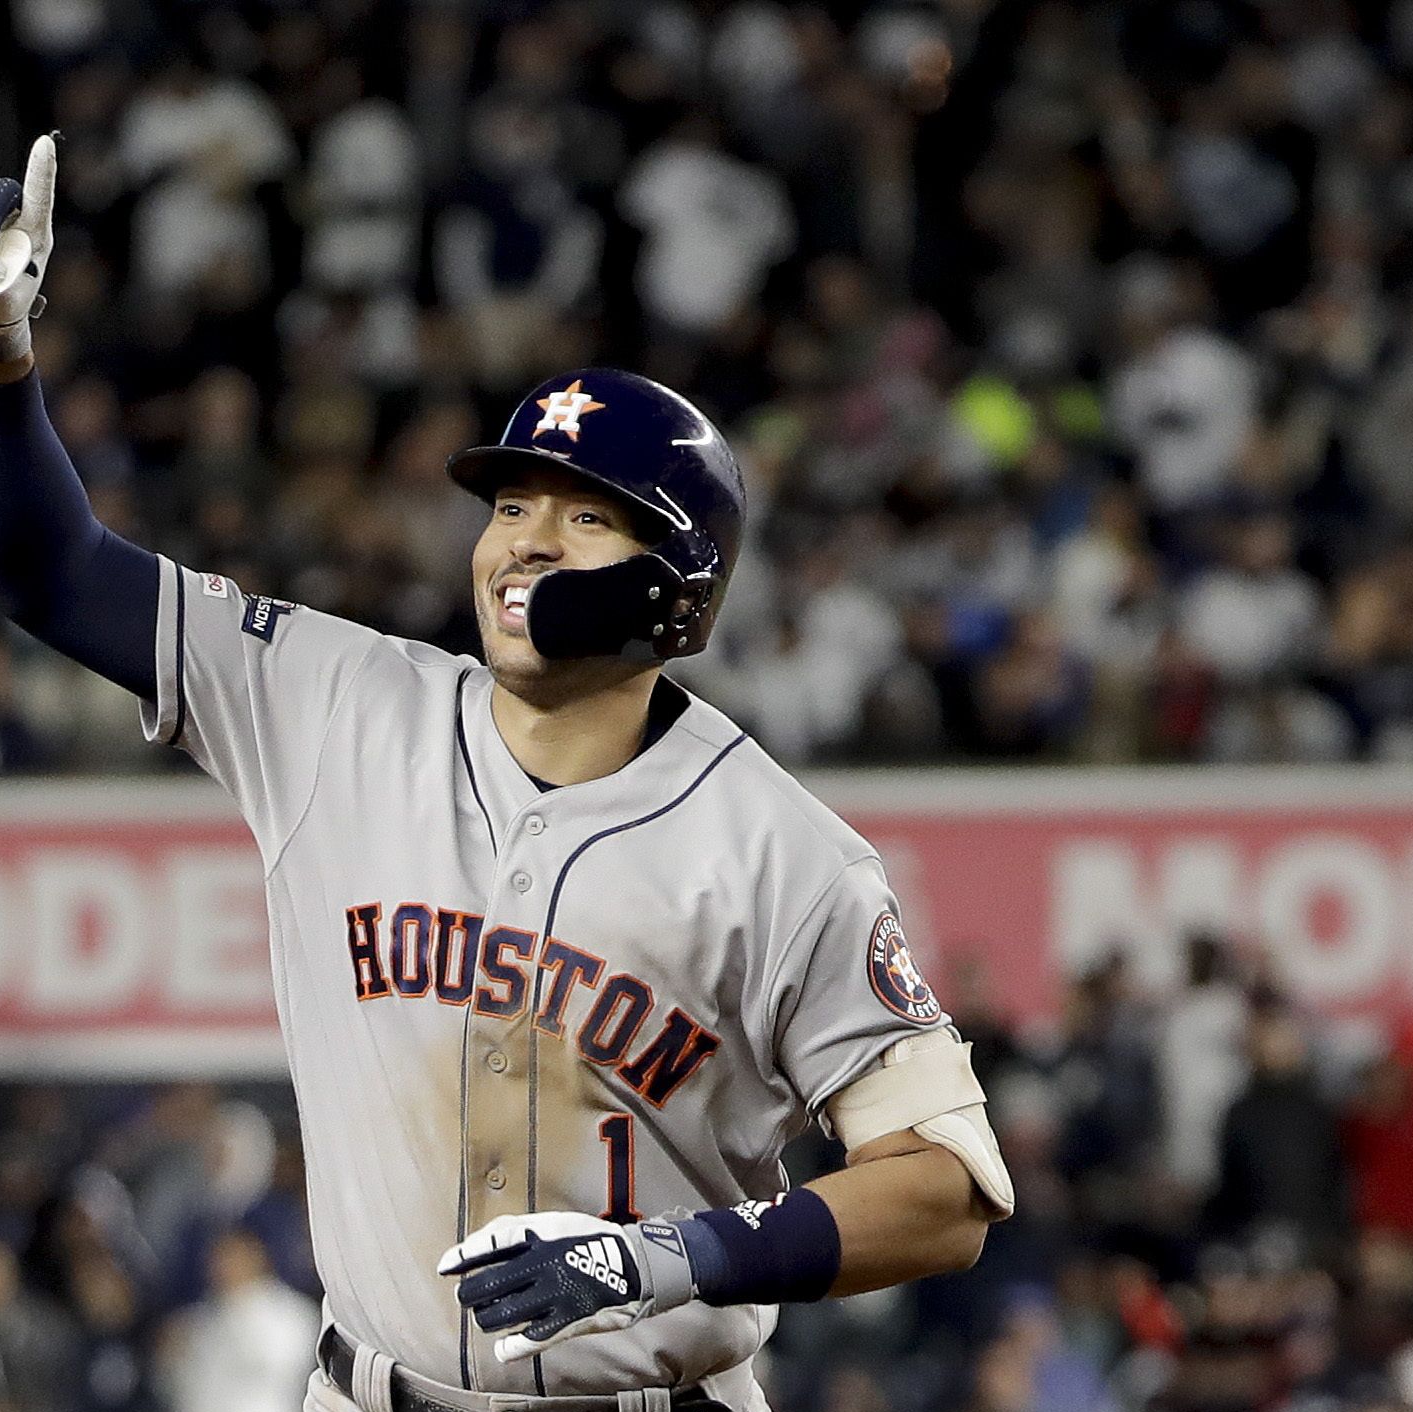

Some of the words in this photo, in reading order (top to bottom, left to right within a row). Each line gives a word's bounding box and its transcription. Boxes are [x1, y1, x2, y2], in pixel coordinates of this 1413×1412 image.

[345, 901, 721, 1110] HOUSTON
[599, 1112, 644, 1224] 1
[565, 1250, 629, 1296] adidas
